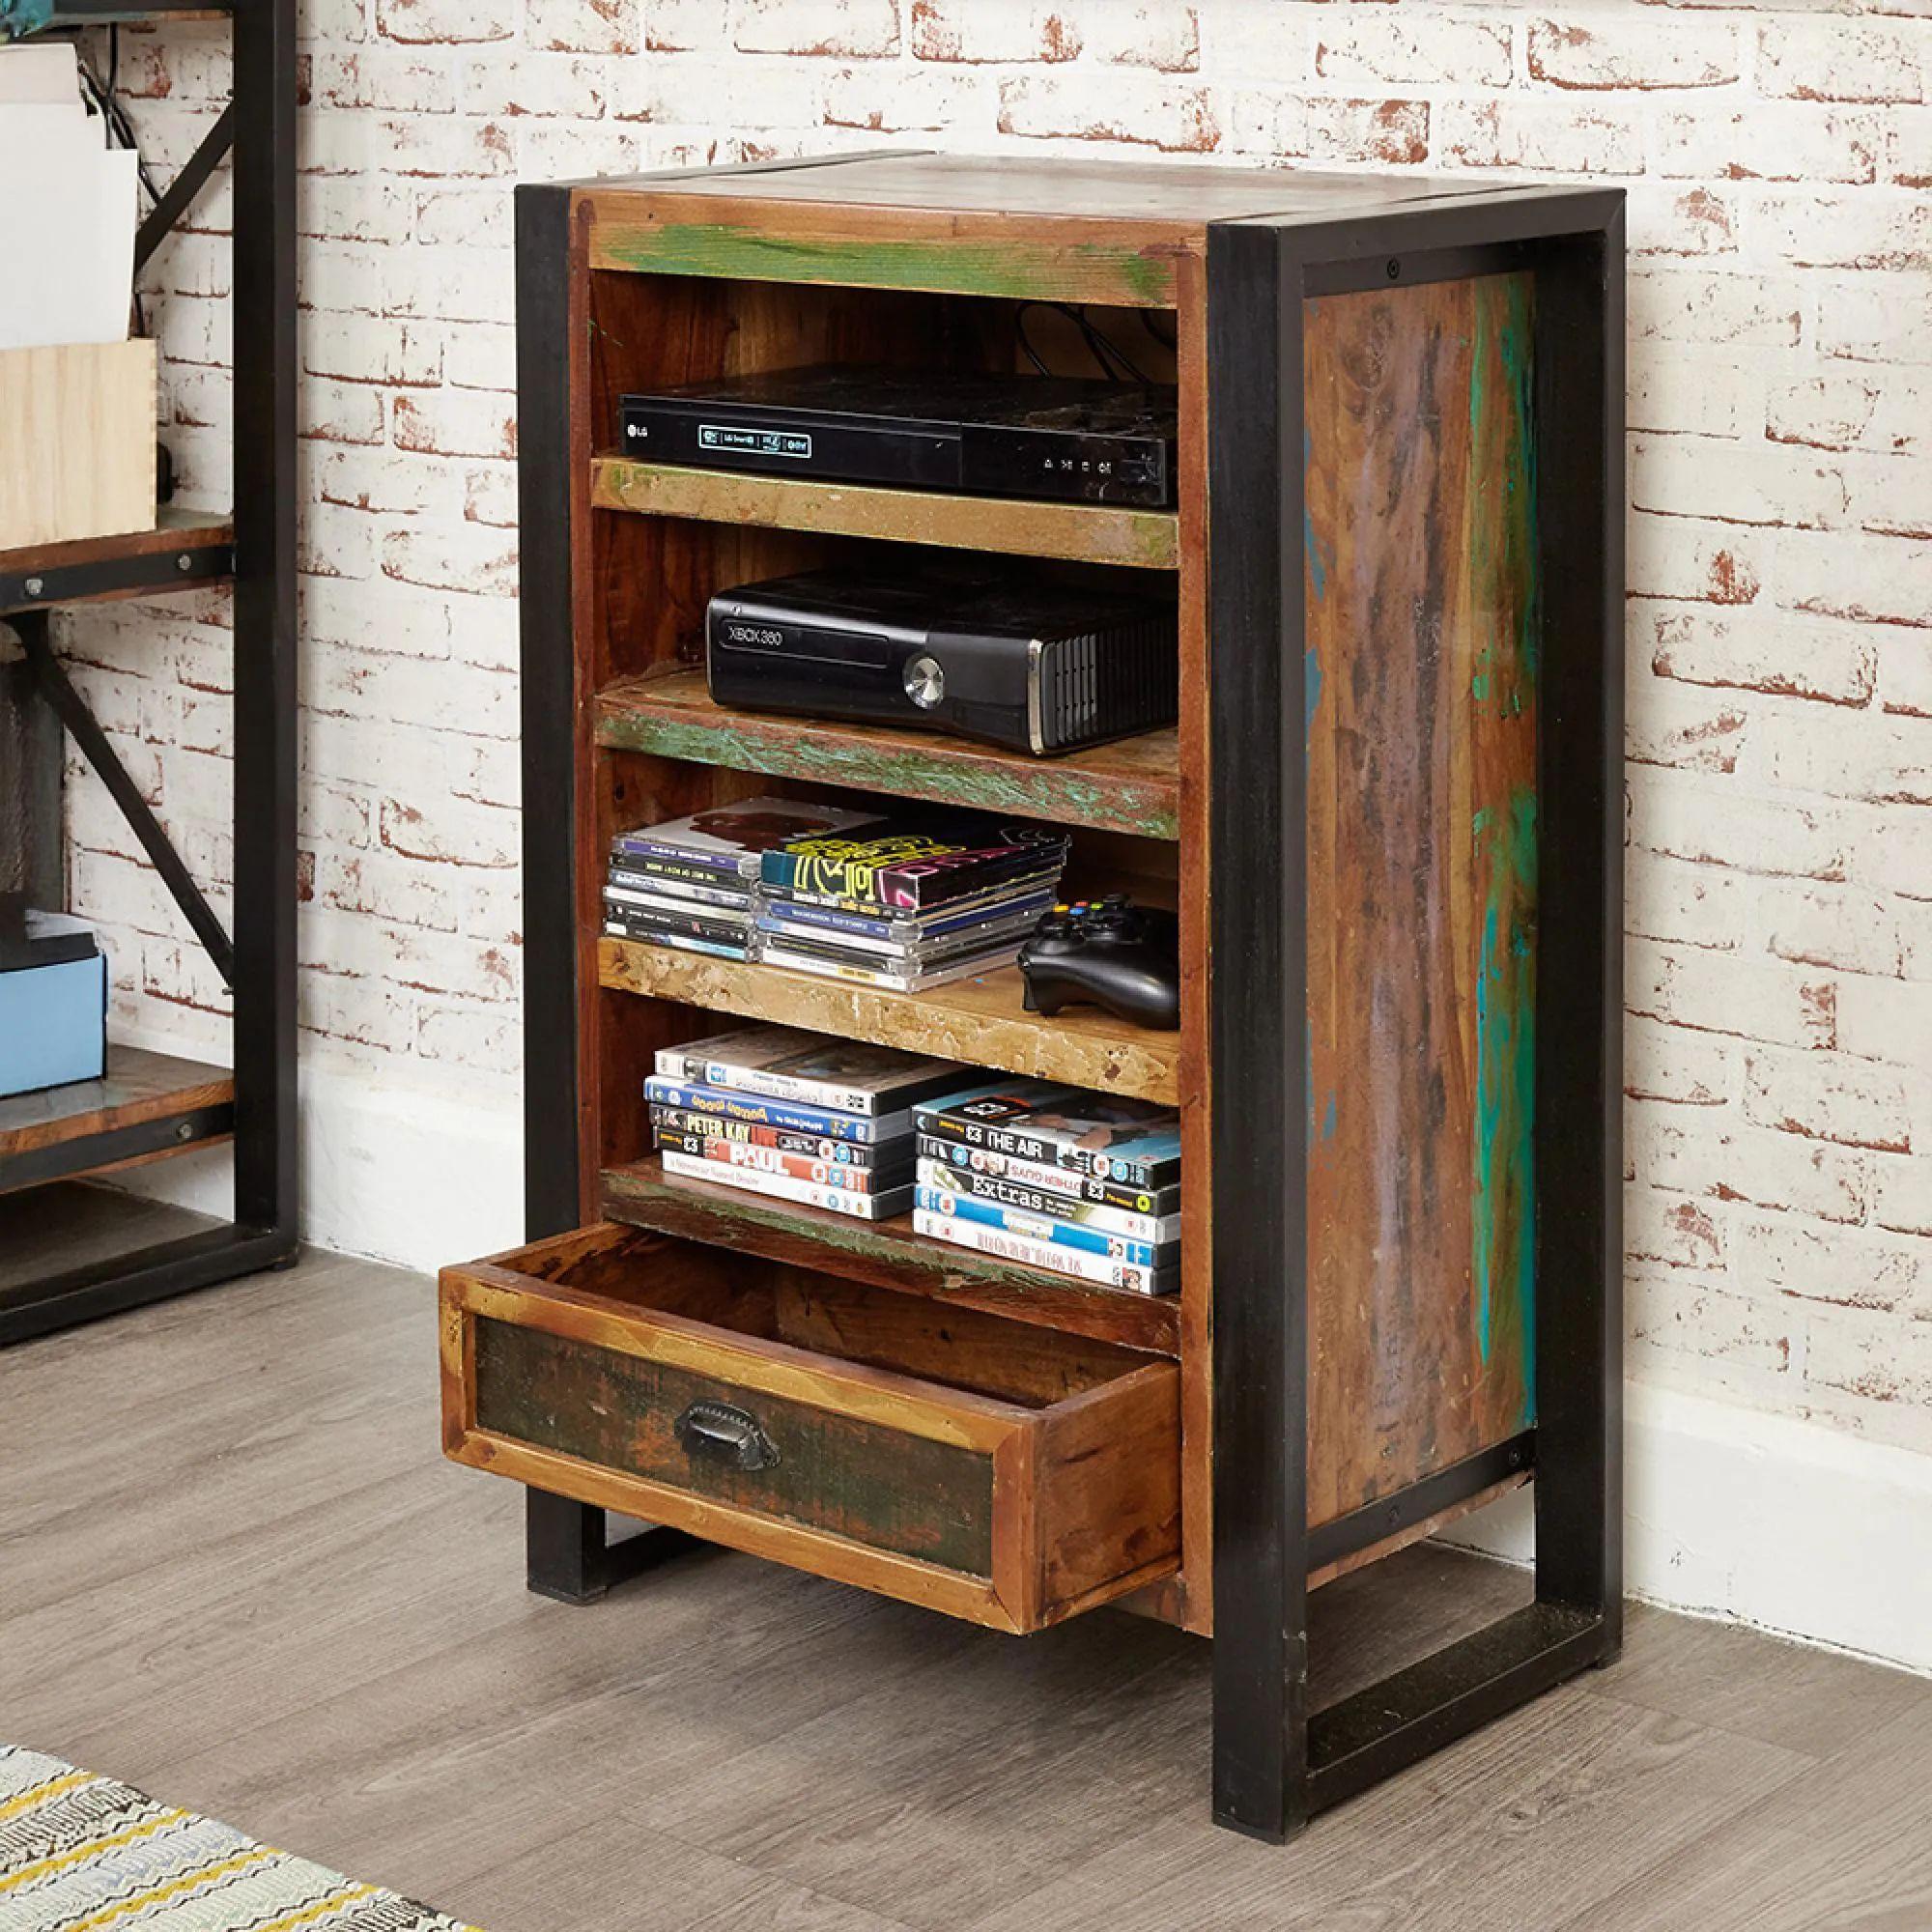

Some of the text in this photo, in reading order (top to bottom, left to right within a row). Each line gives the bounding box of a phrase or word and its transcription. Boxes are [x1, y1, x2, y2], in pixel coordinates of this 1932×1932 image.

[729, 1141, 790, 1176] PAUL
[987, 1130, 1043, 1159] THE AIR
[973, 1177, 1043, 1211] Extras
